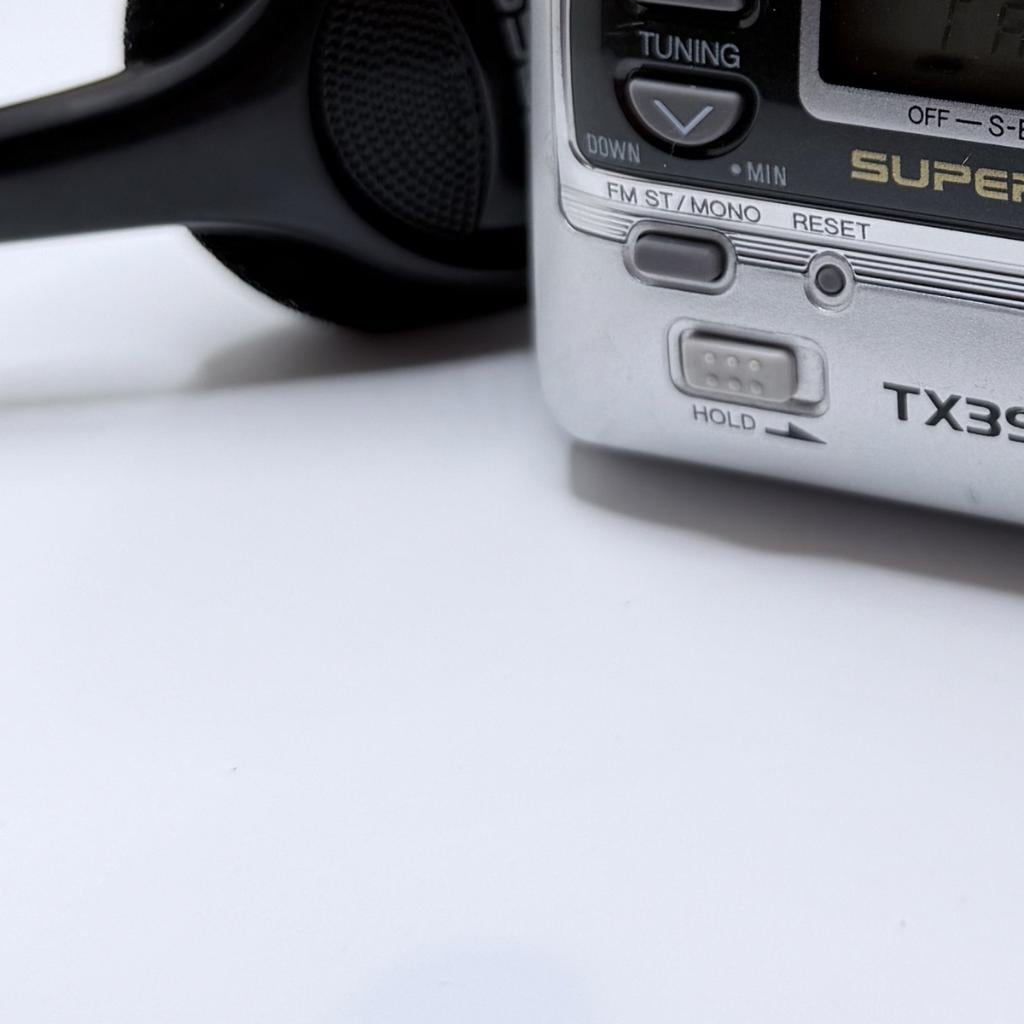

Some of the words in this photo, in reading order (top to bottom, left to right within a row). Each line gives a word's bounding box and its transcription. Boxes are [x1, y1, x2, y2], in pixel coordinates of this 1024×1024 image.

[638, 30, 741, 70] TUNING
[907, 105, 950, 128] OFF
[586, 132, 641, 165] DOWN
[746, 163, 787, 187] MIN
[606, 183, 638, 205] FM
[791, 211, 871, 242] RESET
[692, 405, 757, 432] HOLD
